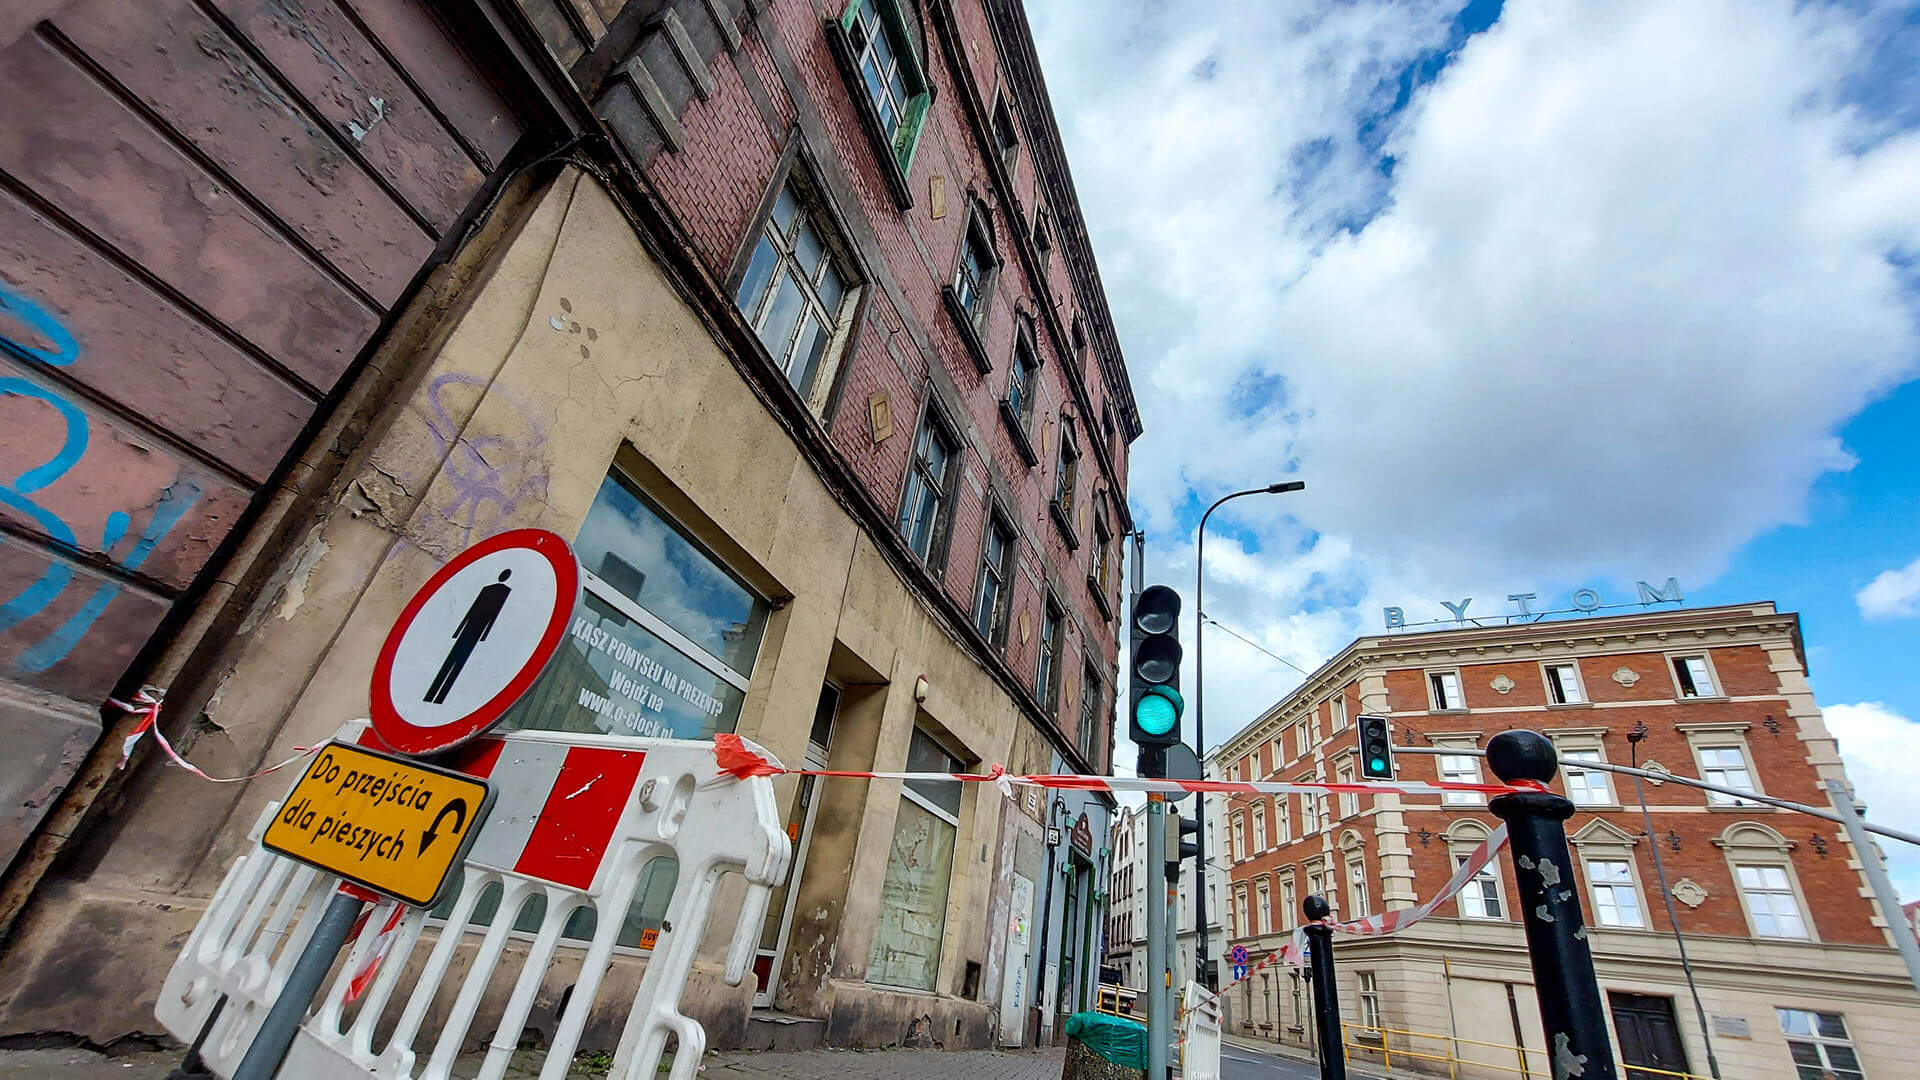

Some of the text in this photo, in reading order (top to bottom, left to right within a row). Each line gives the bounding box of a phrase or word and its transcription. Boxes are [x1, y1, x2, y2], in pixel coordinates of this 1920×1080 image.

[1383, 577, 1684, 628] BYTOM
[571, 616, 723, 717] KASZ POMYSŁU NA PREZENT?
[609, 669, 664, 713] Wejdź na
[577, 687, 675, 739] www.o-clockpl
[311, 754, 434, 812] Do przejścia
[283, 798, 404, 861] dla pieszych
